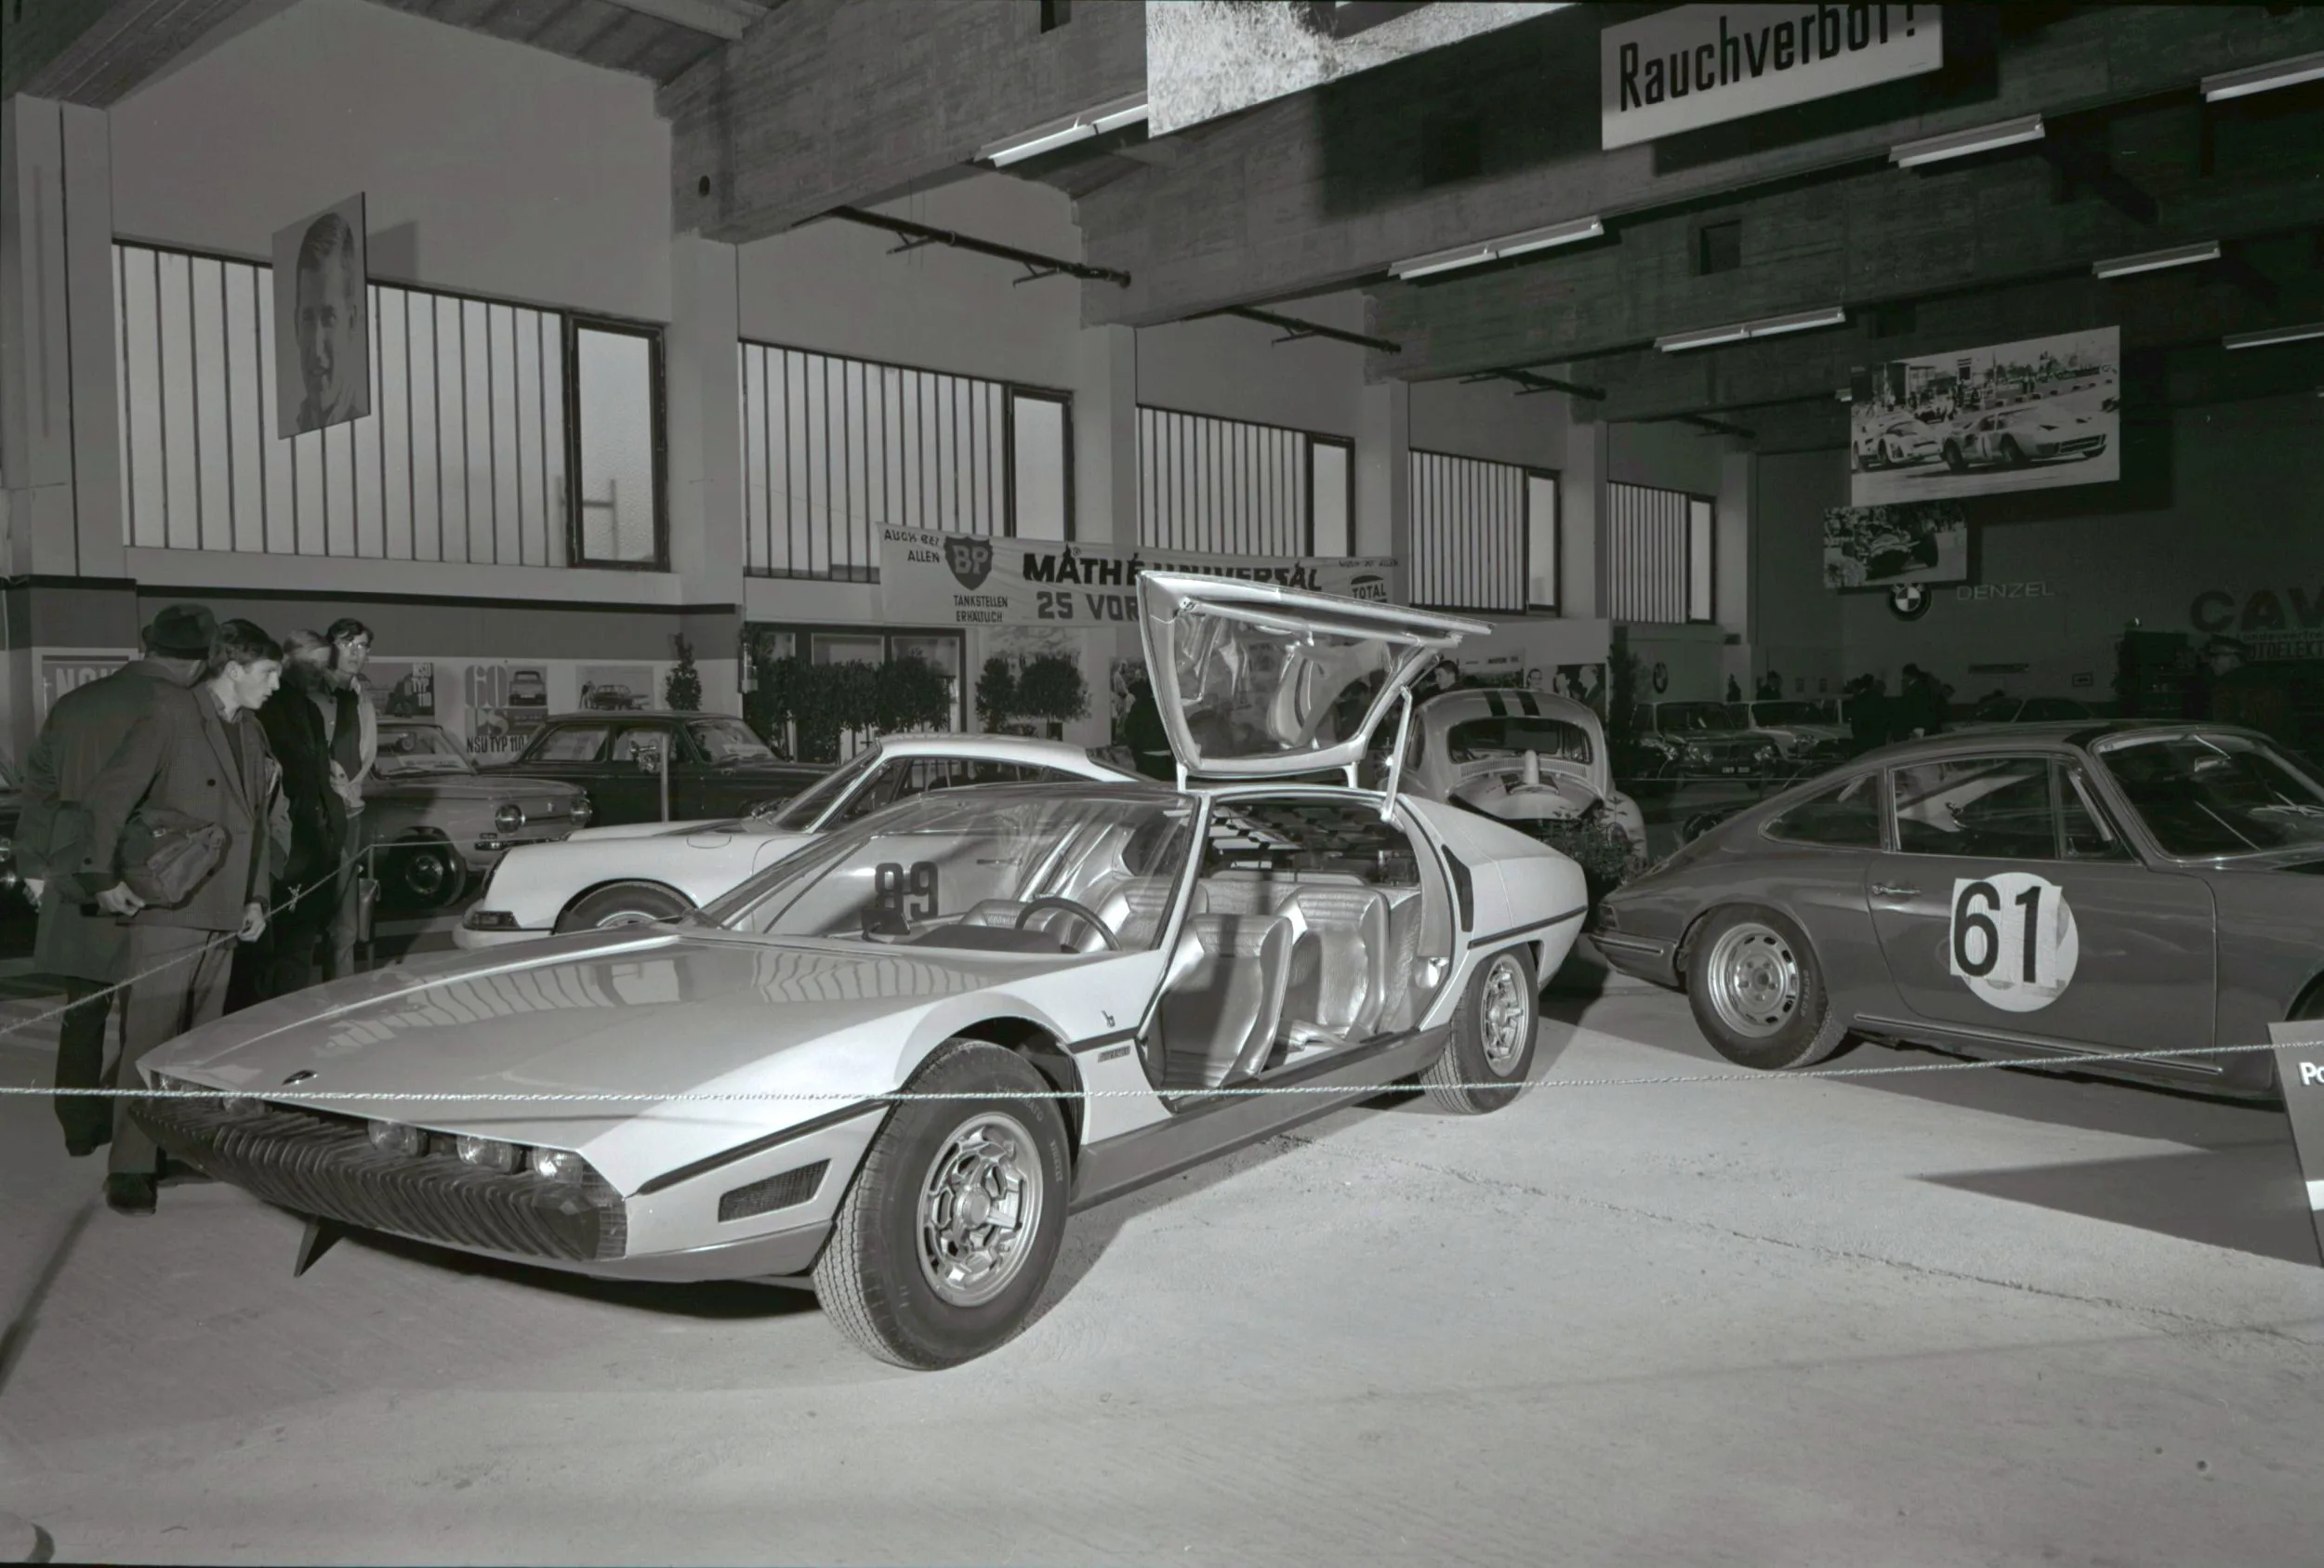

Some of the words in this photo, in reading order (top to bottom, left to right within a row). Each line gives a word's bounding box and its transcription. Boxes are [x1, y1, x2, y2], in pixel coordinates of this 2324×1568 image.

[1620, 4, 1915, 112] Rauchverbot!
[907, 549, 940, 562] ALLEN
[952, 545, 989, 574] BP
[1154, 560, 1322, 592] ERSAL
[1353, 583, 1386, 600] TOTAL
[1956, 581, 2055, 601] DENZEL
[953, 594, 1009, 609] TANKSTELLEN
[1037, 591, 1074, 620] 25
[413, 664, 431, 678] NSU
[412, 678, 429, 692] TYP
[467, 735, 488, 753] NSU
[490, 734, 508, 753] TYP
[875, 861, 938, 921] 89
[1954, 881, 2041, 984] 61
